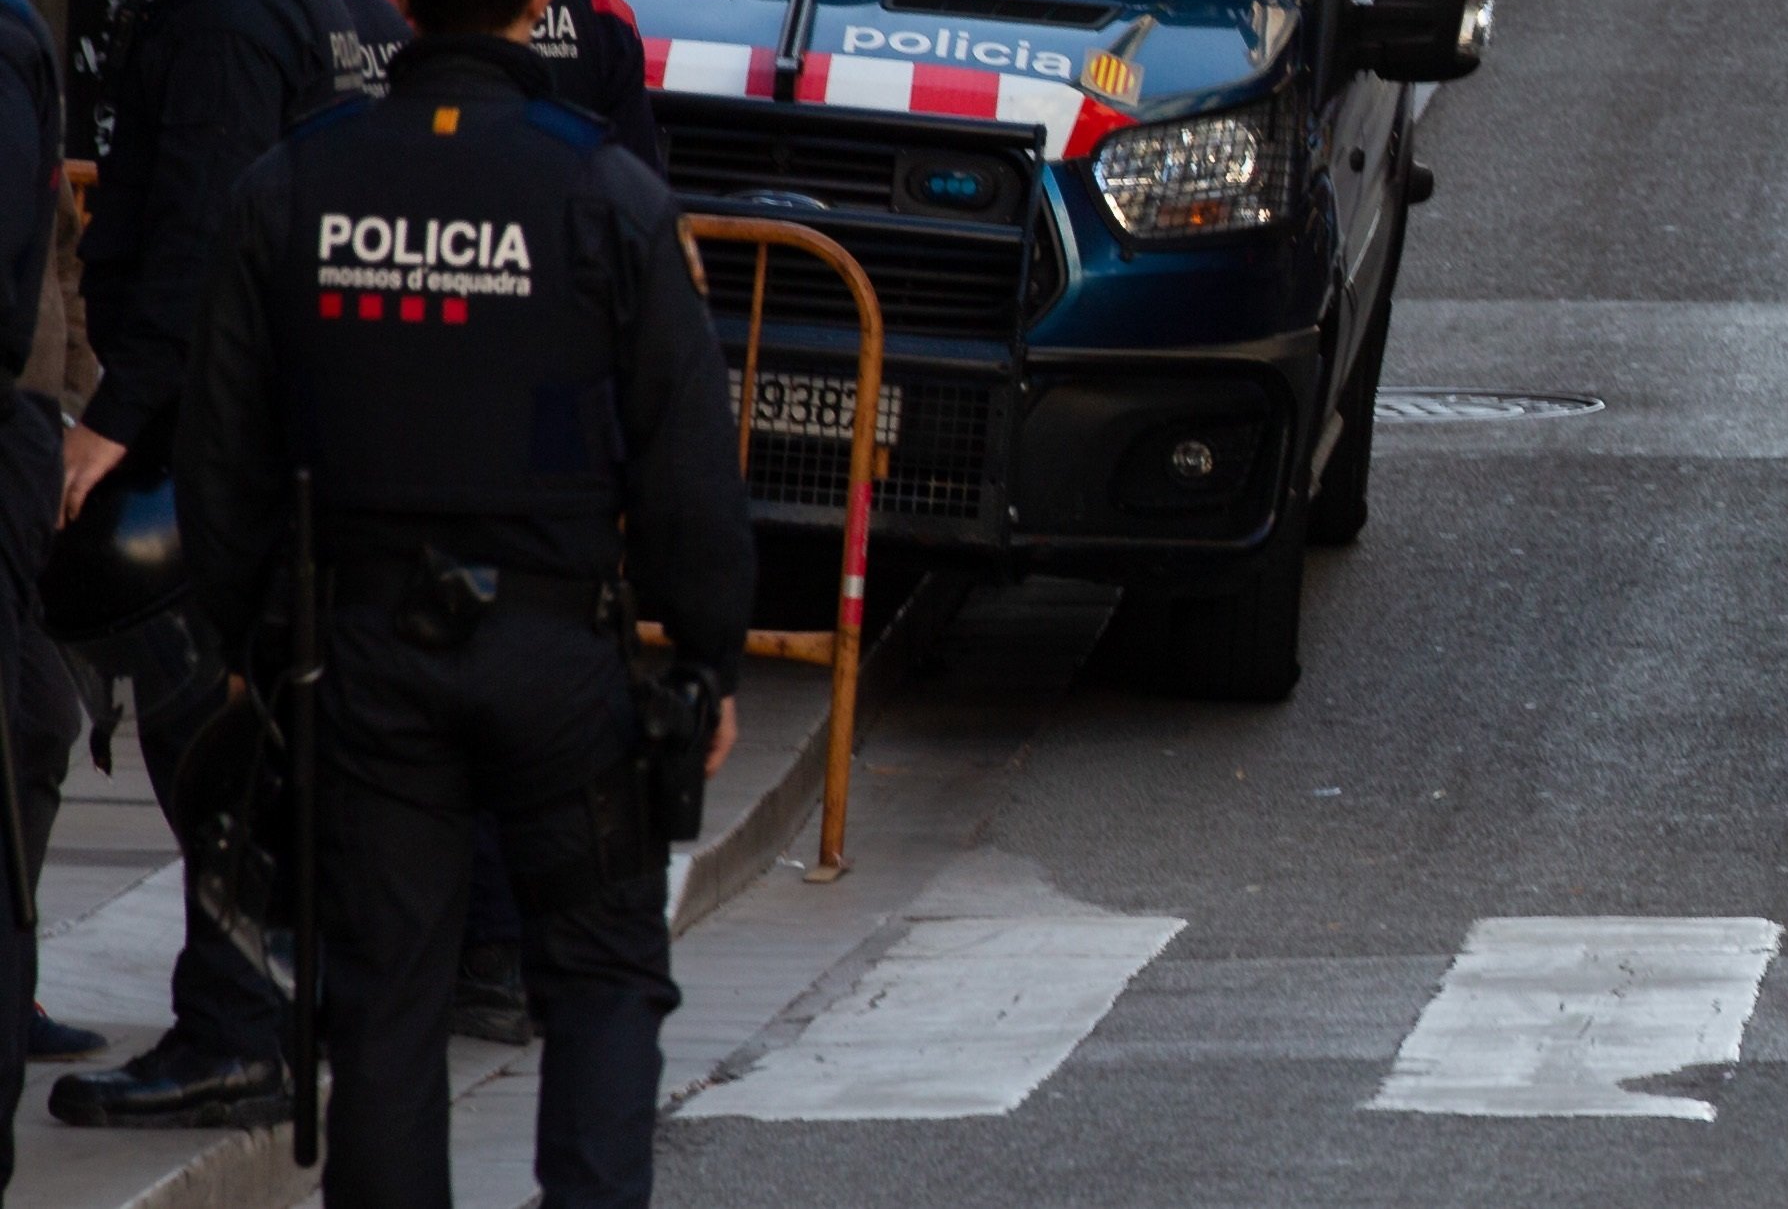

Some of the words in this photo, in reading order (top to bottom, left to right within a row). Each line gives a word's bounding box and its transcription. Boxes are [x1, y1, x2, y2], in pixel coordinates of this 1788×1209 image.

[842, 24, 1072, 80] policia
[318, 213, 531, 270] POLICIA
[318, 266, 402, 289] mossos
